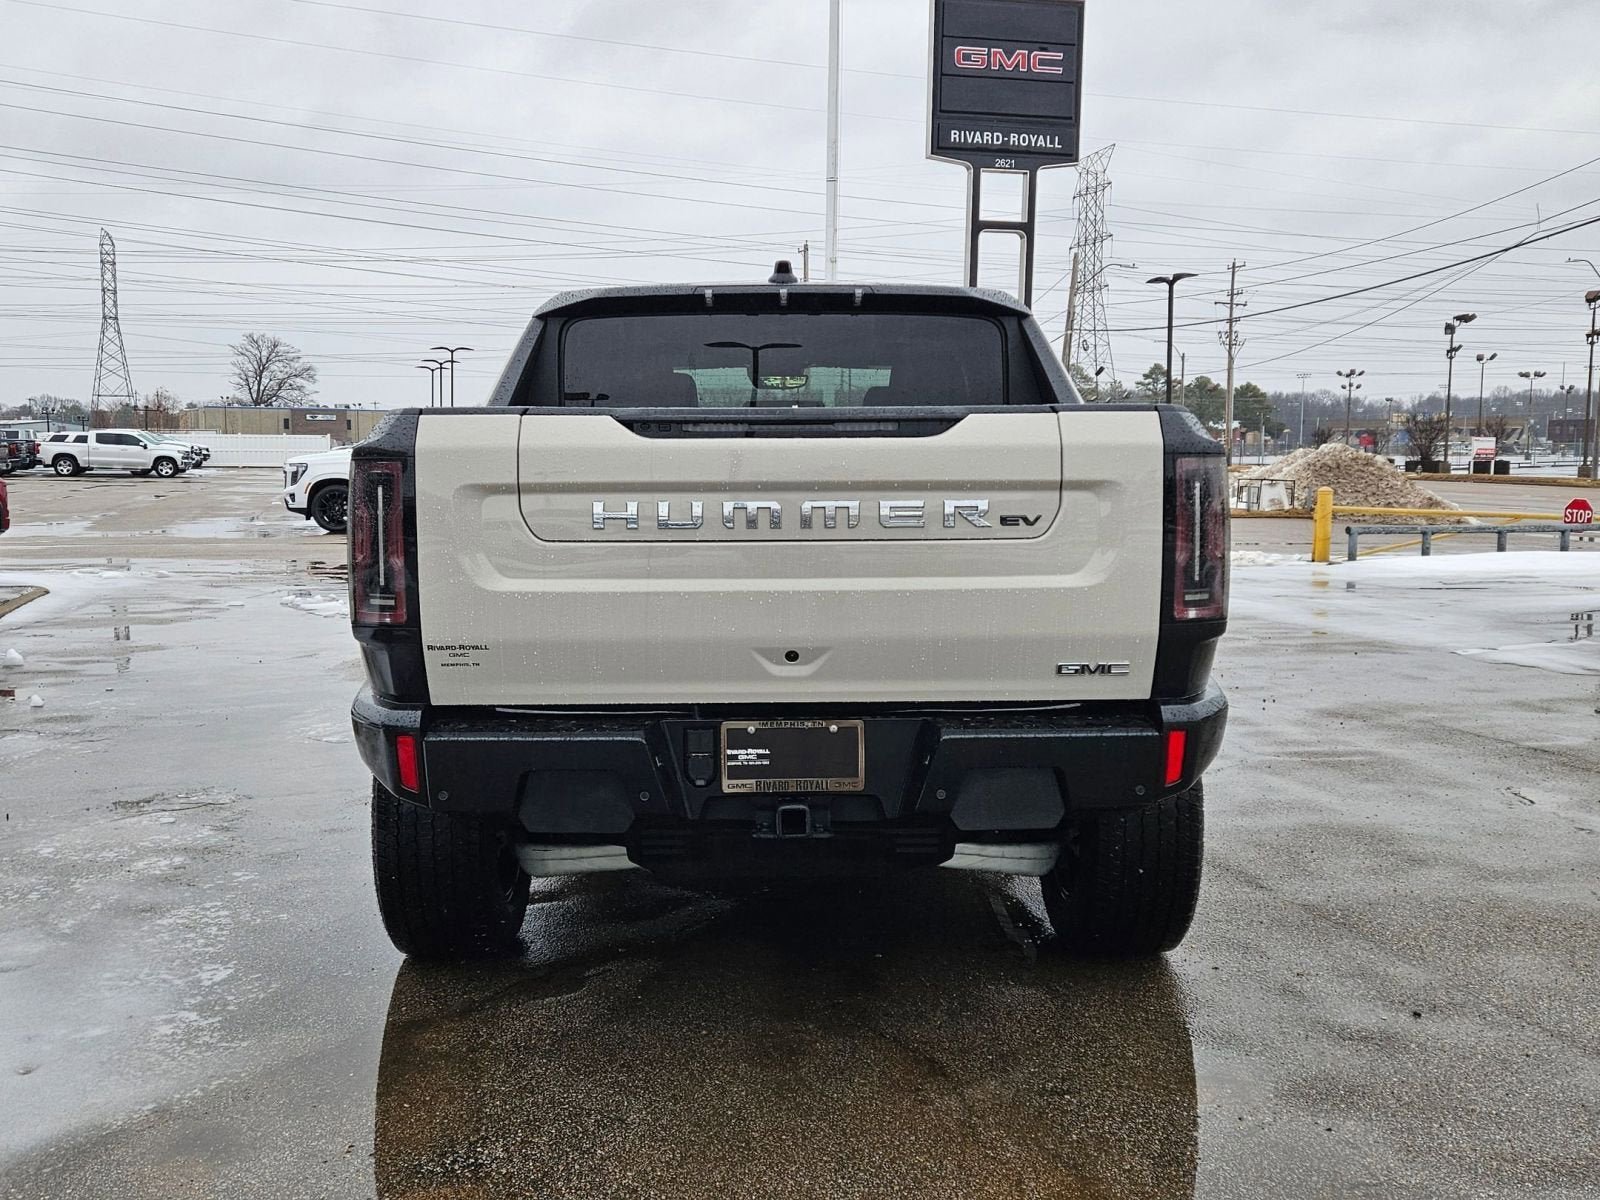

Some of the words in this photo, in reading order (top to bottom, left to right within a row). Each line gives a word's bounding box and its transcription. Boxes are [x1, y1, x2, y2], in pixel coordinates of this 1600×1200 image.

[954, 46, 1063, 74] GMC
[950, 129, 1063, 148] RIVARD-ROYALL
[995, 159, 1015, 168] 2621
[592, 500, 992, 529] HUMMER
[999, 515, 1042, 527] EV
[1565, 509, 1592, 522] STOP
[1057, 662, 1130, 676] GMC
